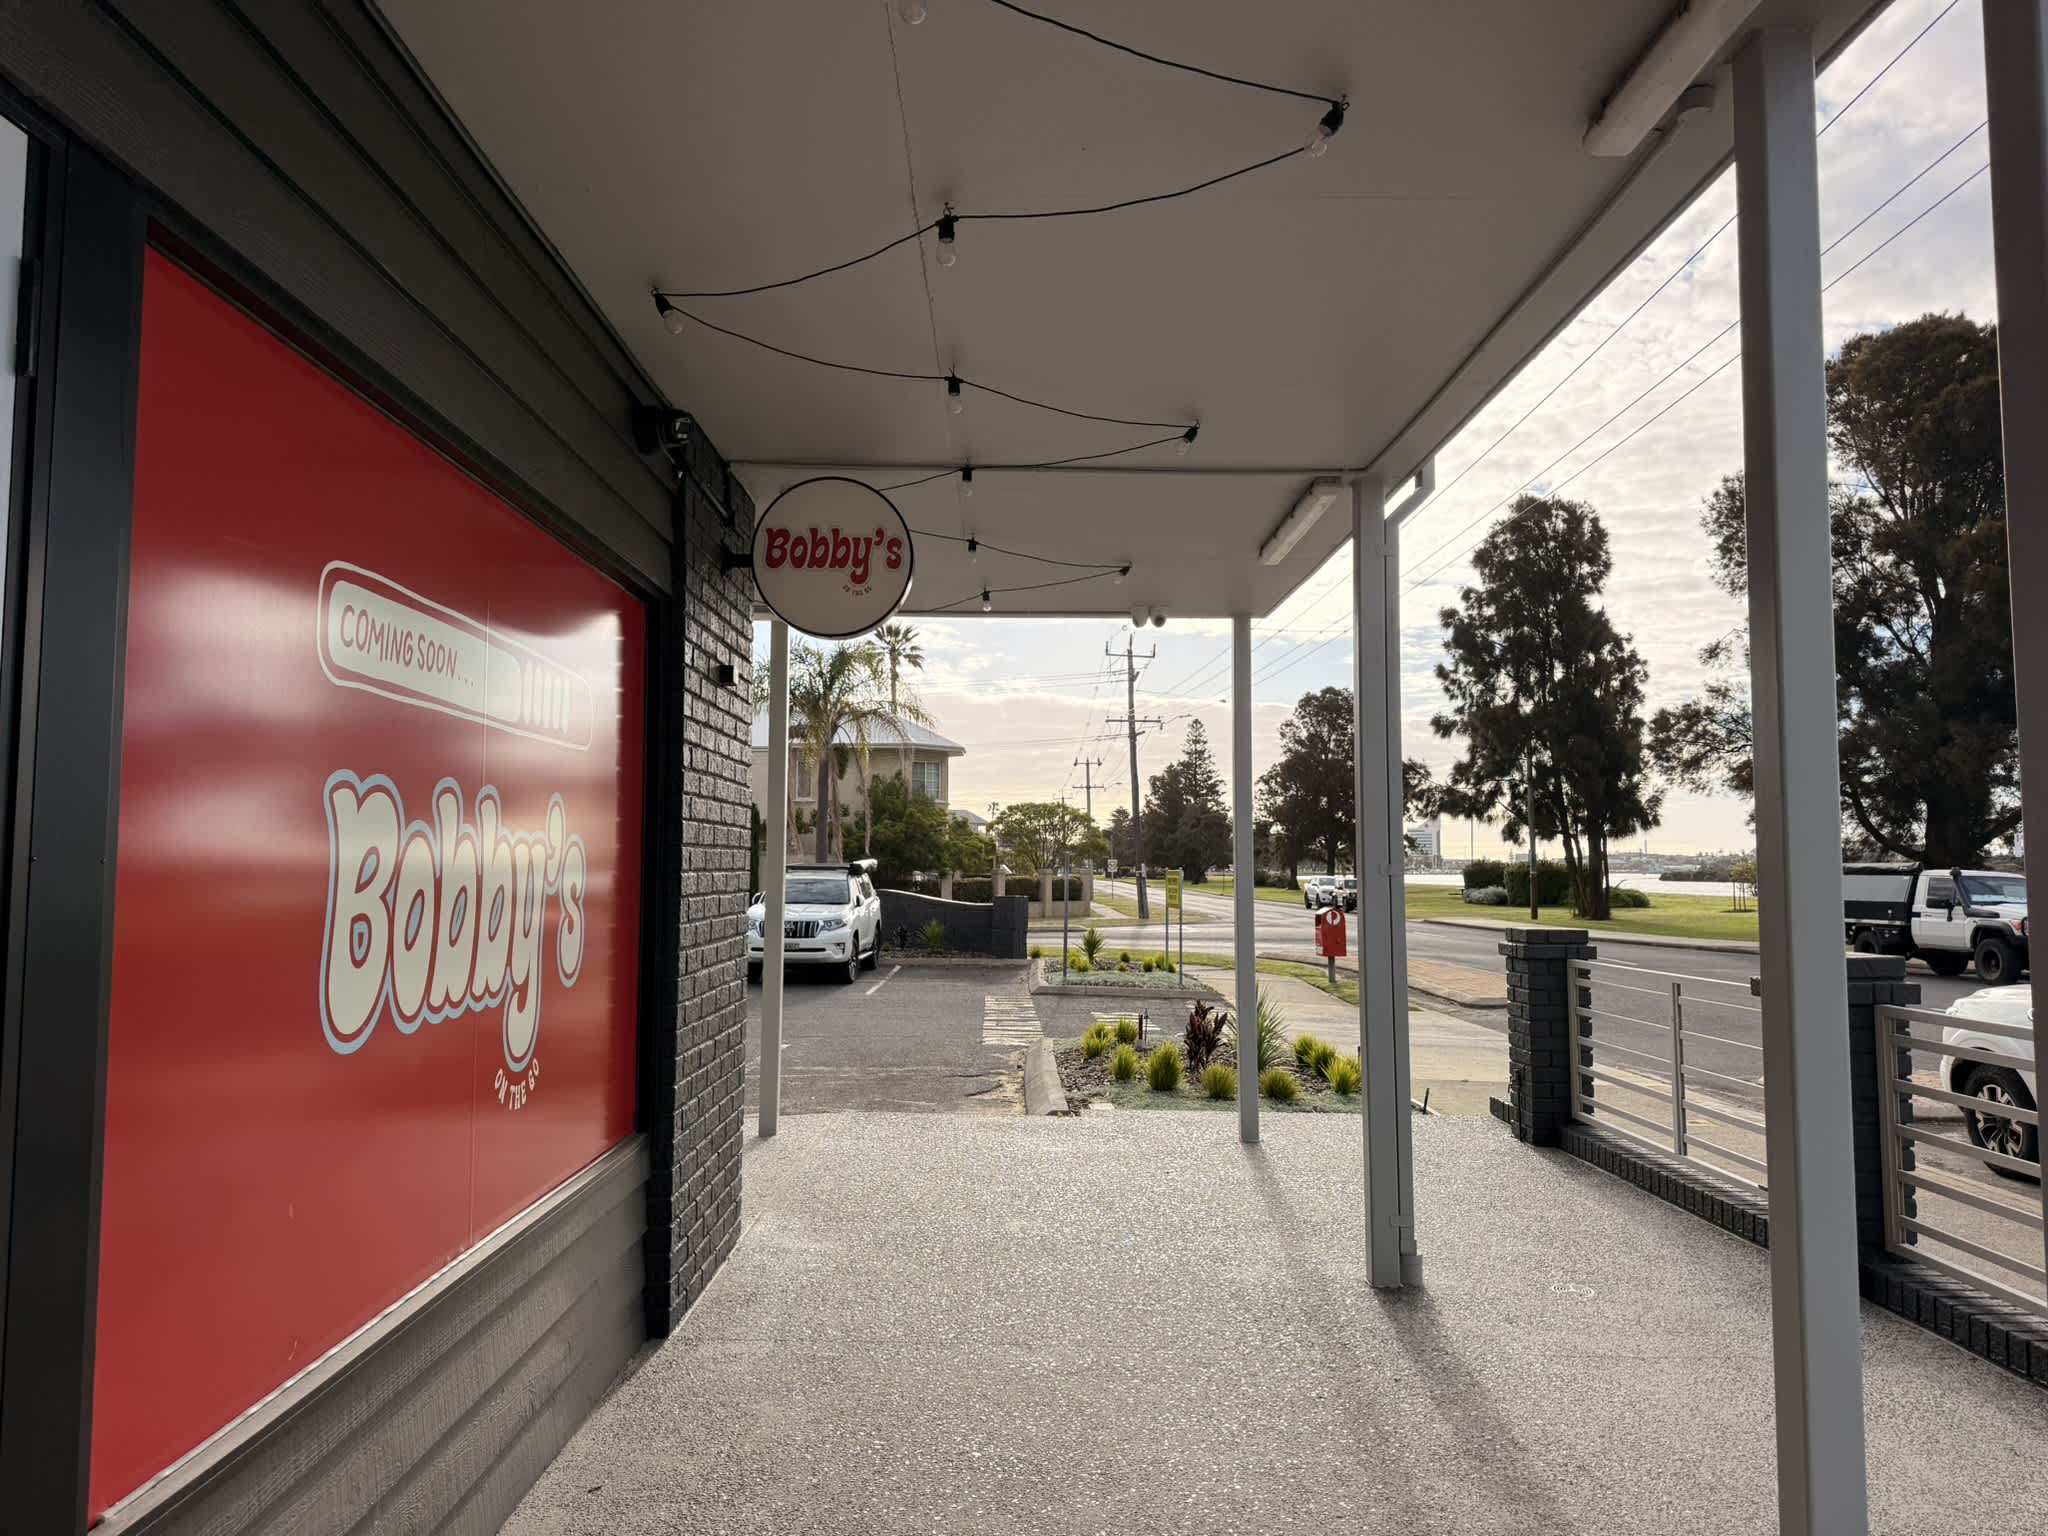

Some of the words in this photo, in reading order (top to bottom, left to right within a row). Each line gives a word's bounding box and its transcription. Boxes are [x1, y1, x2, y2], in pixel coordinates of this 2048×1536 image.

[765, 527, 903, 585] Bobby's
[340, 604, 413, 667] COMING
[326, 785, 584, 1059] Bobby's
[495, 1068, 508, 1105] ON
[509, 1080, 527, 1110] THE
[528, 1058, 540, 1091] GO
